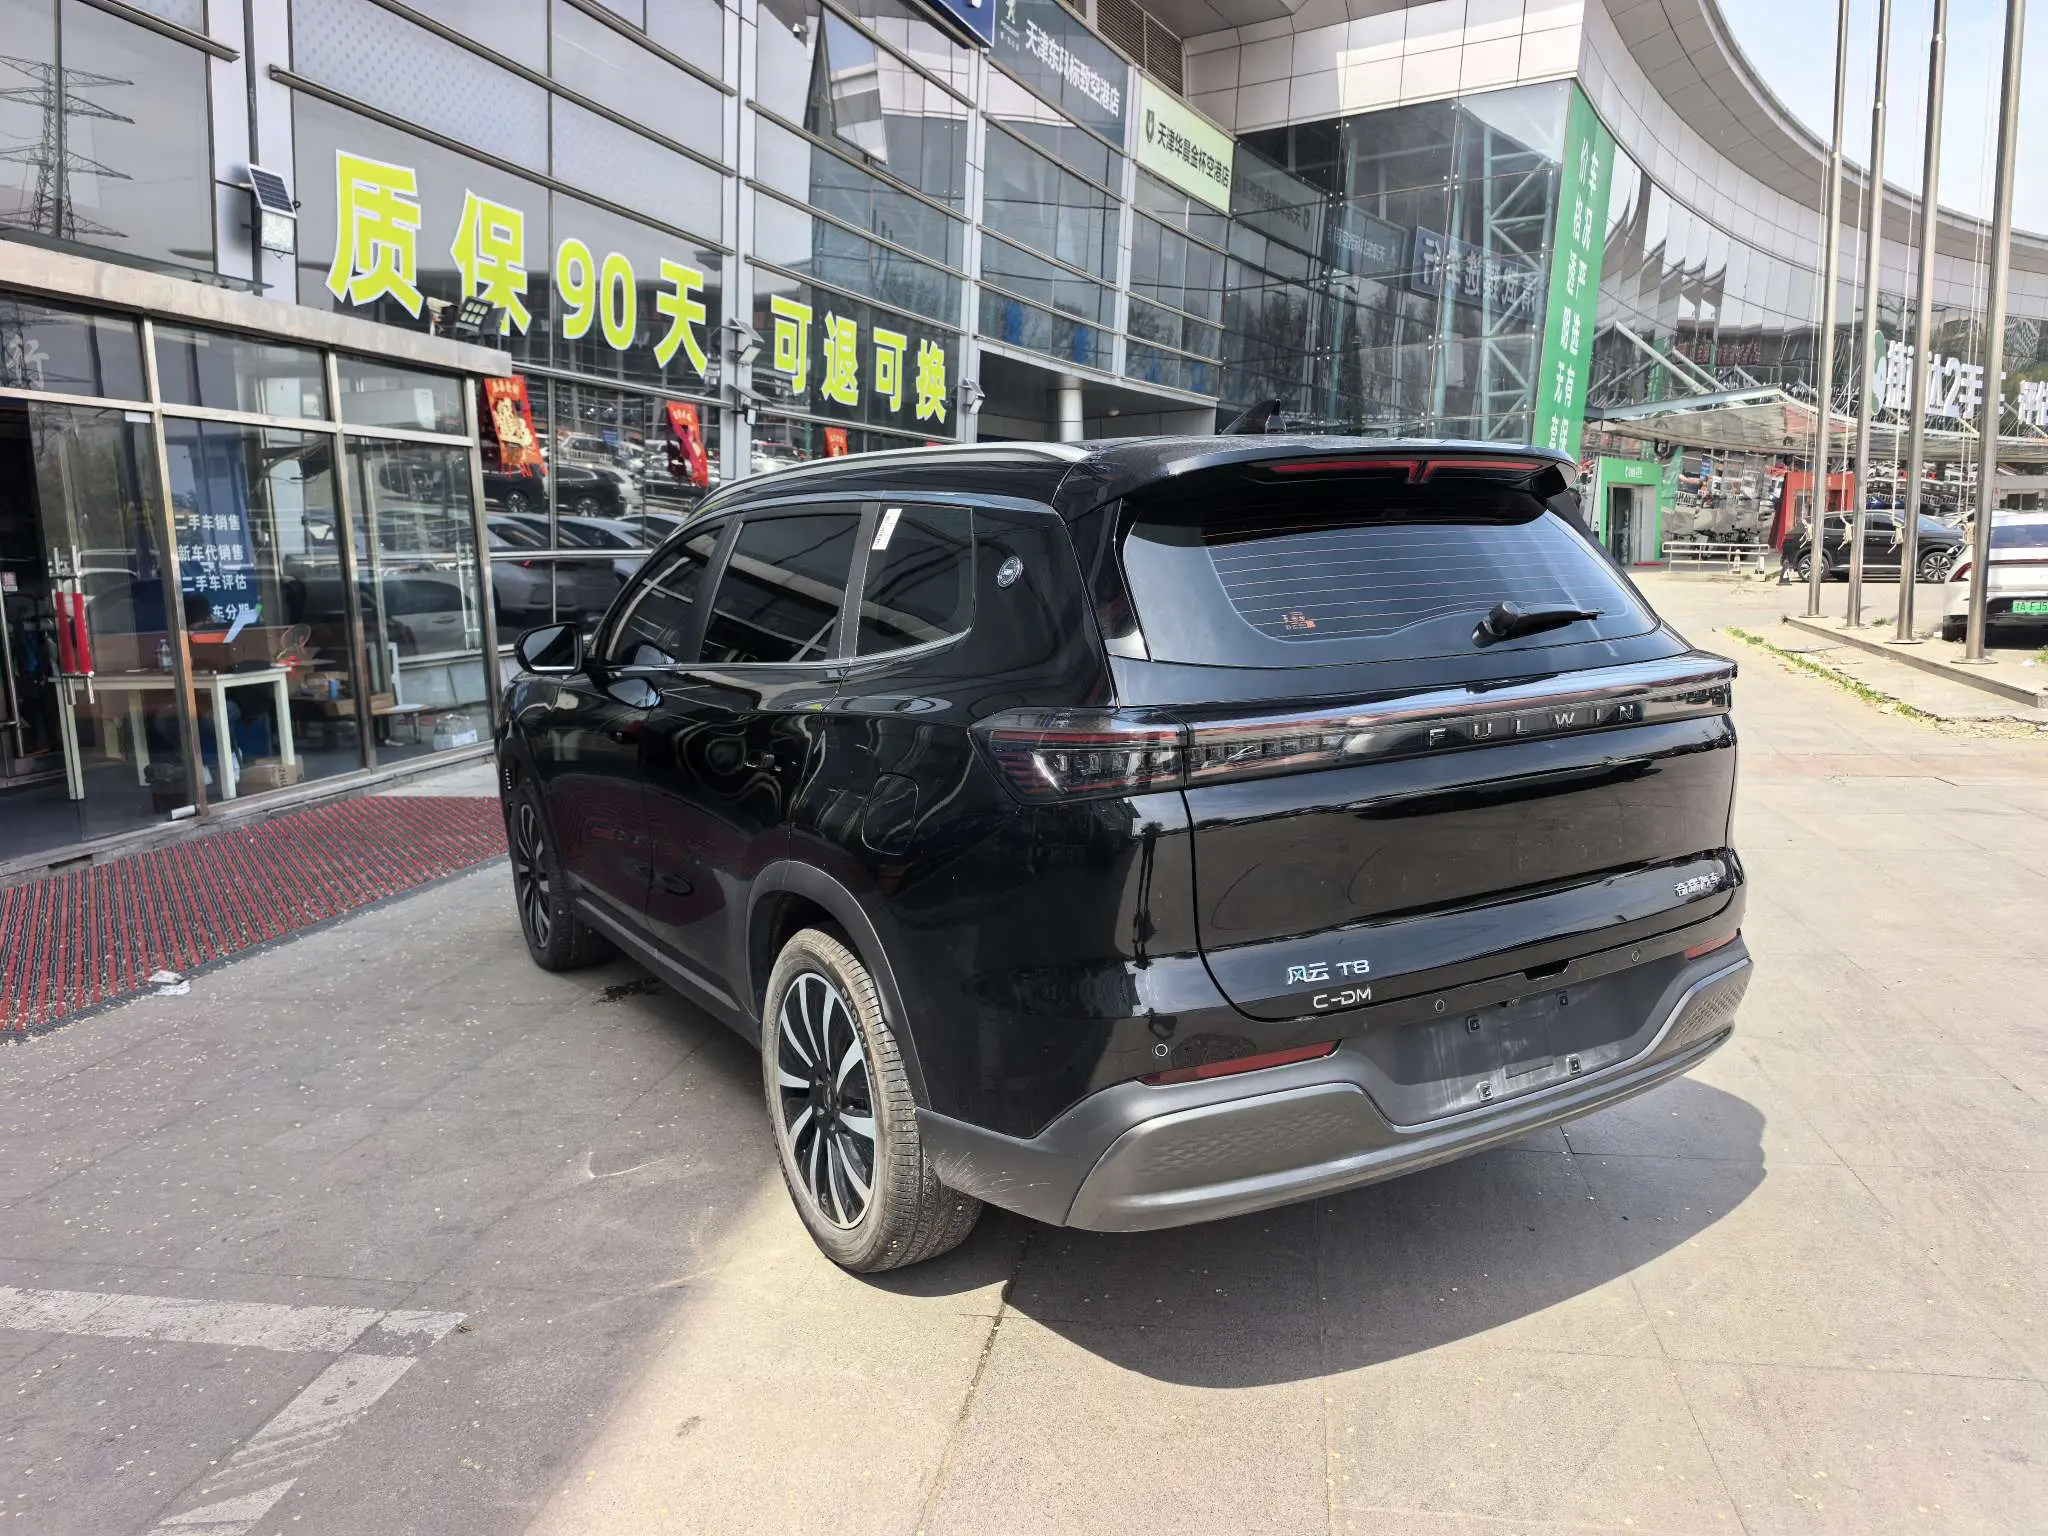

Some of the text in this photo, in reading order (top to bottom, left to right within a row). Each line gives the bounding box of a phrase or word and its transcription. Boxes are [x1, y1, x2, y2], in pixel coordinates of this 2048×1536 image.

[1025, 18, 1121, 119] 天津东风标致空港店
[1157, 121, 1230, 188] 天津华晨金杯空港店
[325, 149, 947, 424] 质保90天 可退可换
[175, 514, 241, 531] 二手车销售
[178, 544, 244, 562] 新车代销售
[182, 574, 247, 592] 二手车评估
[1429, 705, 1634, 748] FULWIN
[1286, 962, 1330, 985] 风云
[1313, 986, 1372, 1009] C-DM
